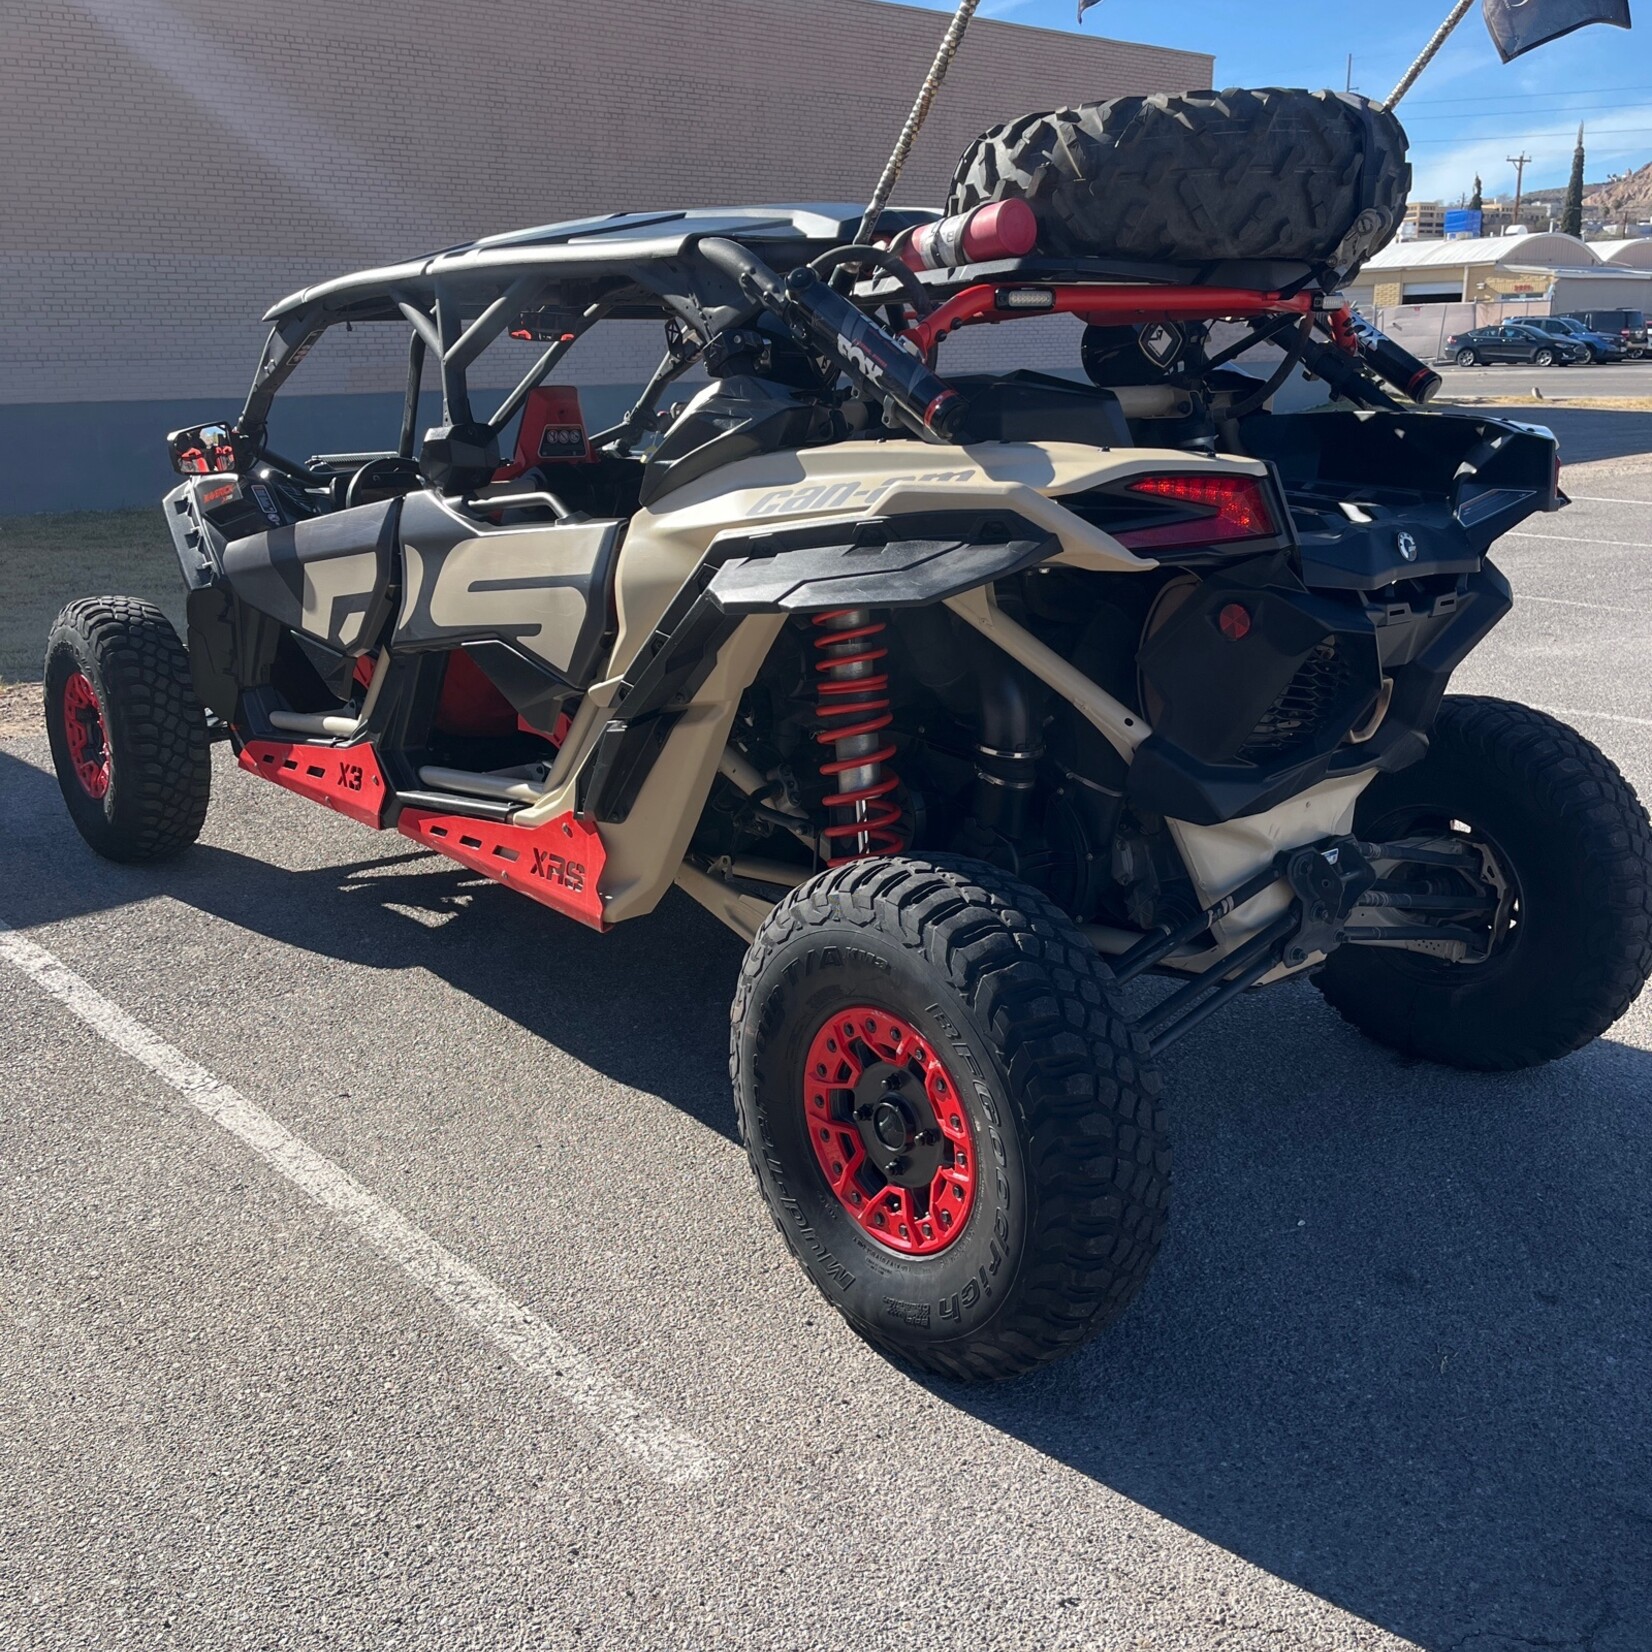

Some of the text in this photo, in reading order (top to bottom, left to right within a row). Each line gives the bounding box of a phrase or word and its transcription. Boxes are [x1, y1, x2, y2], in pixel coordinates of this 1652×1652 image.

[337, 762, 363, 791] X3
[530, 847, 586, 893] XRS
[924, 1002, 1011, 1324] BFGoodrich
